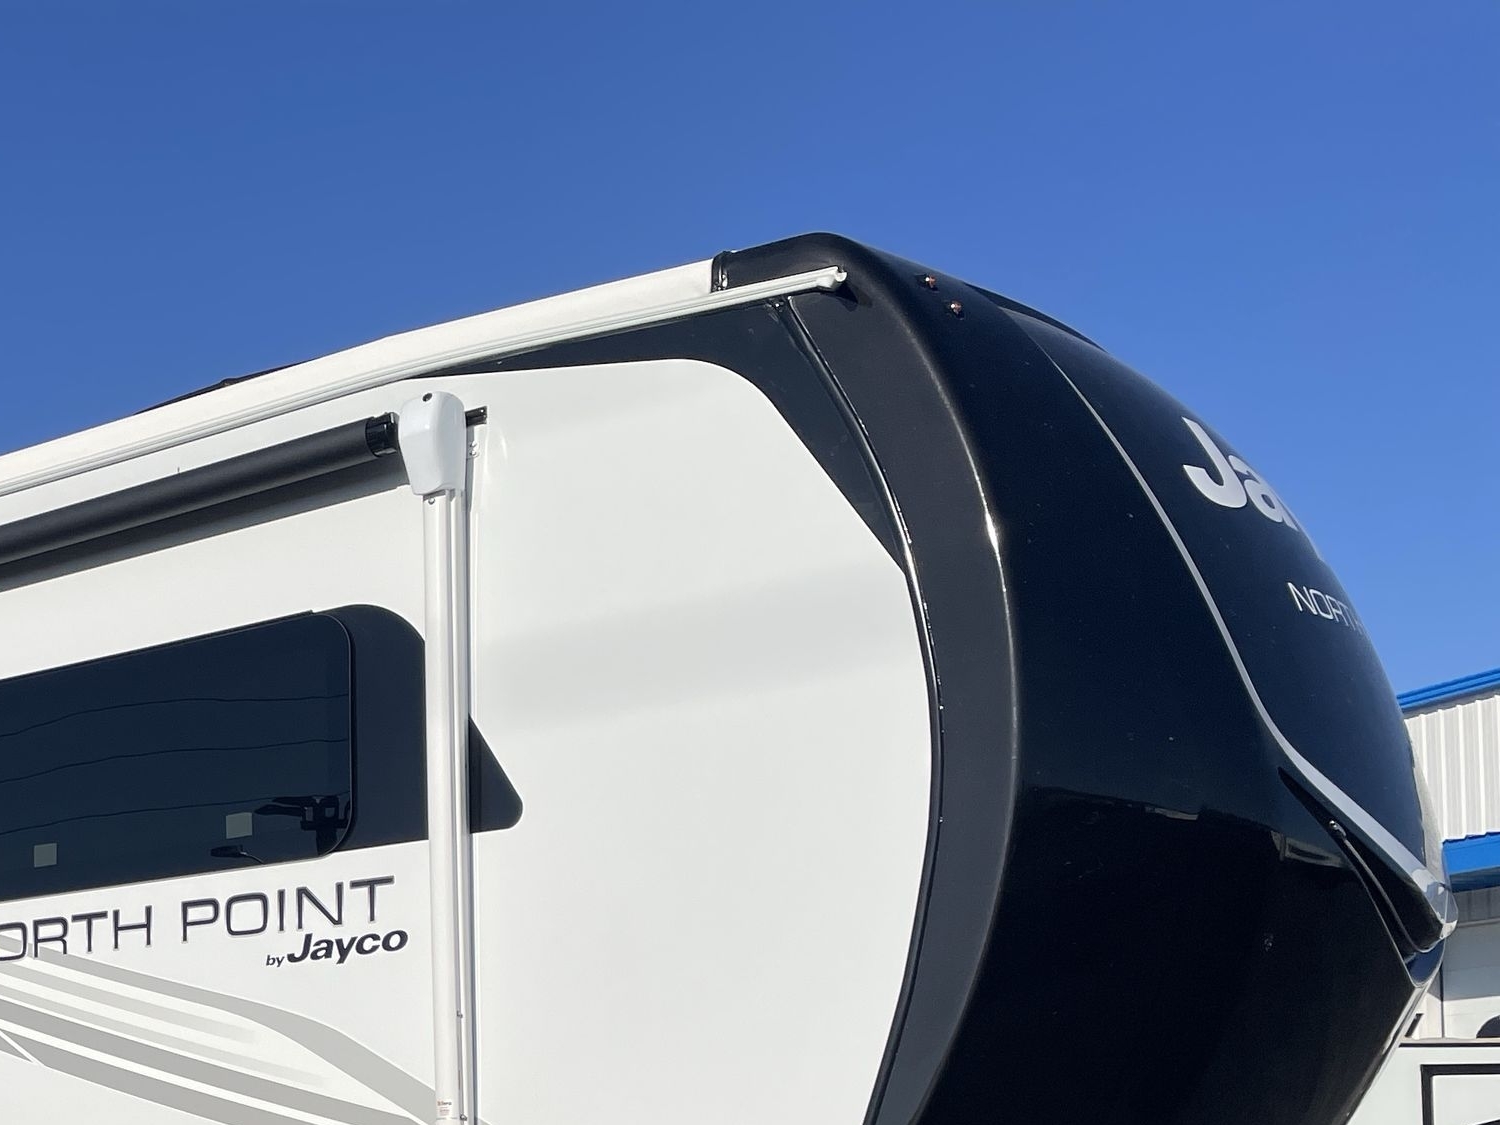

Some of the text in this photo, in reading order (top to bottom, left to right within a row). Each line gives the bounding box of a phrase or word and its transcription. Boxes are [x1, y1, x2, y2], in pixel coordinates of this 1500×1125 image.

[1182, 416, 1300, 532] Ja
[180, 875, 395, 943] POINT
[266, 929, 408, 969] by Jayco
